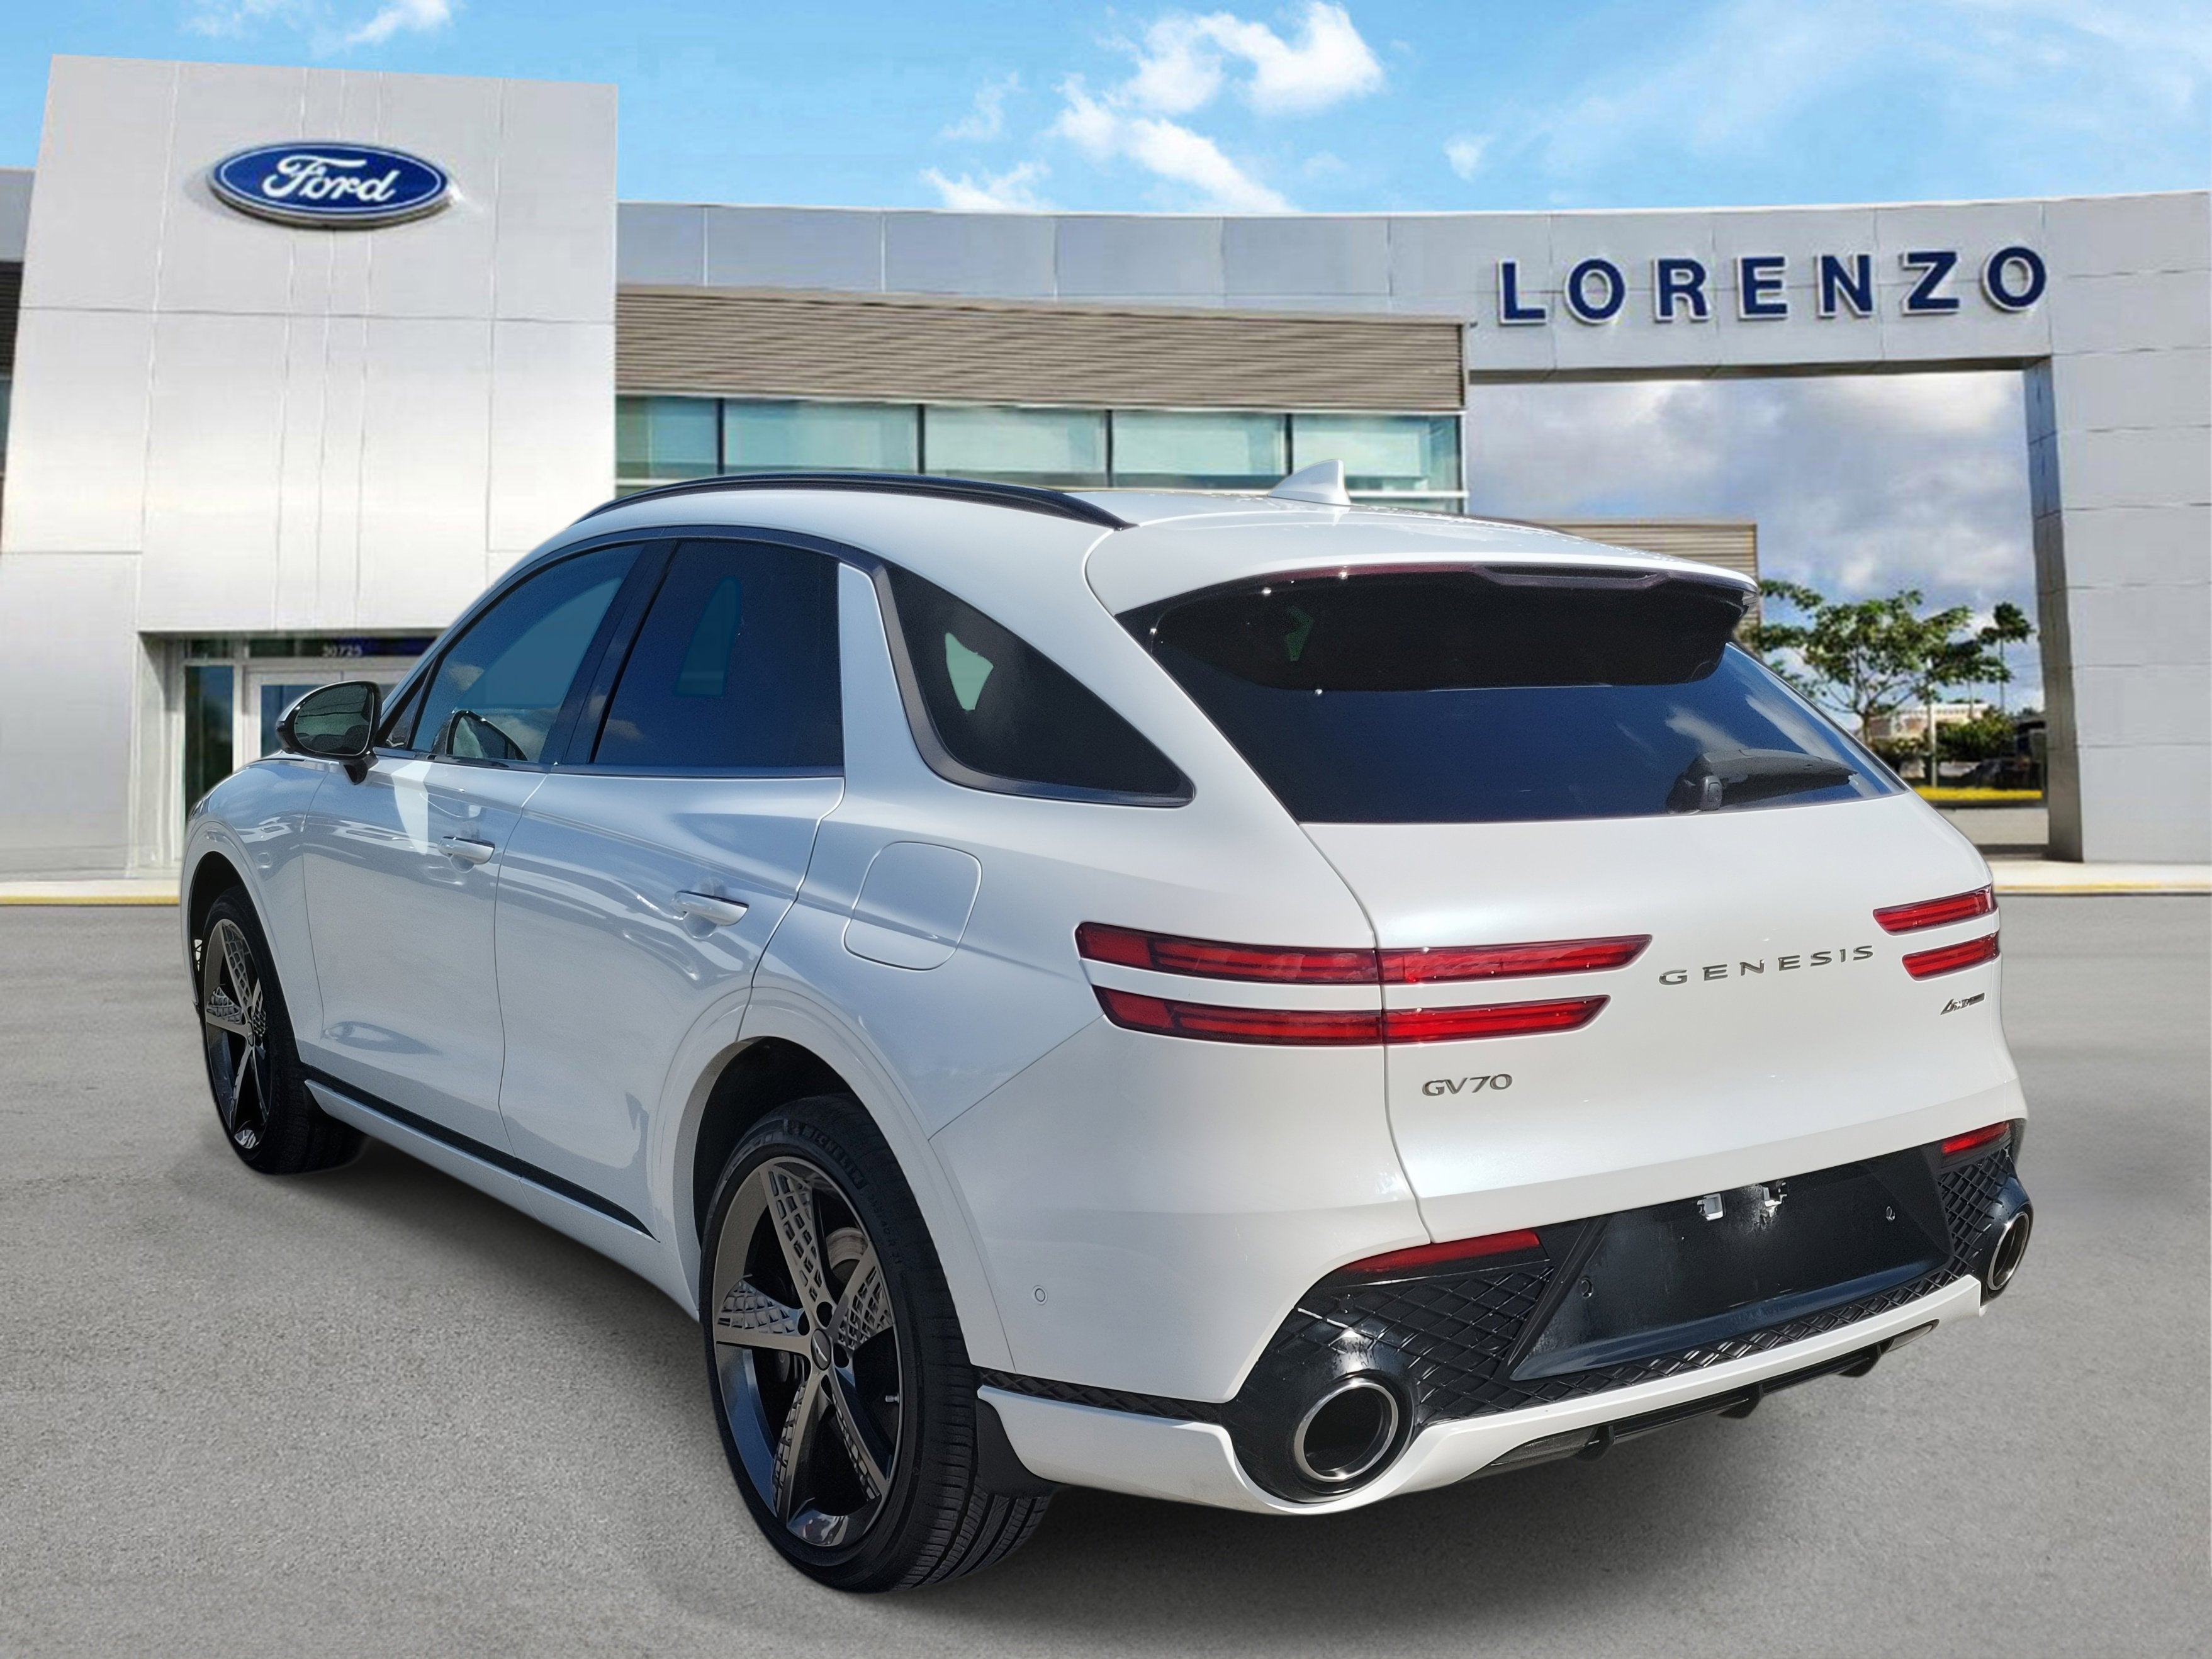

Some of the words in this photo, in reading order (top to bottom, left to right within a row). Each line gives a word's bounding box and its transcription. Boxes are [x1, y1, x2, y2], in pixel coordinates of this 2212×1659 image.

[262, 155, 401, 201] Ford
[1498, 246, 2047, 324] LORENZO
[1659, 945, 1873, 986] GENESIS
[1422, 1074, 1513, 1096] GV70
